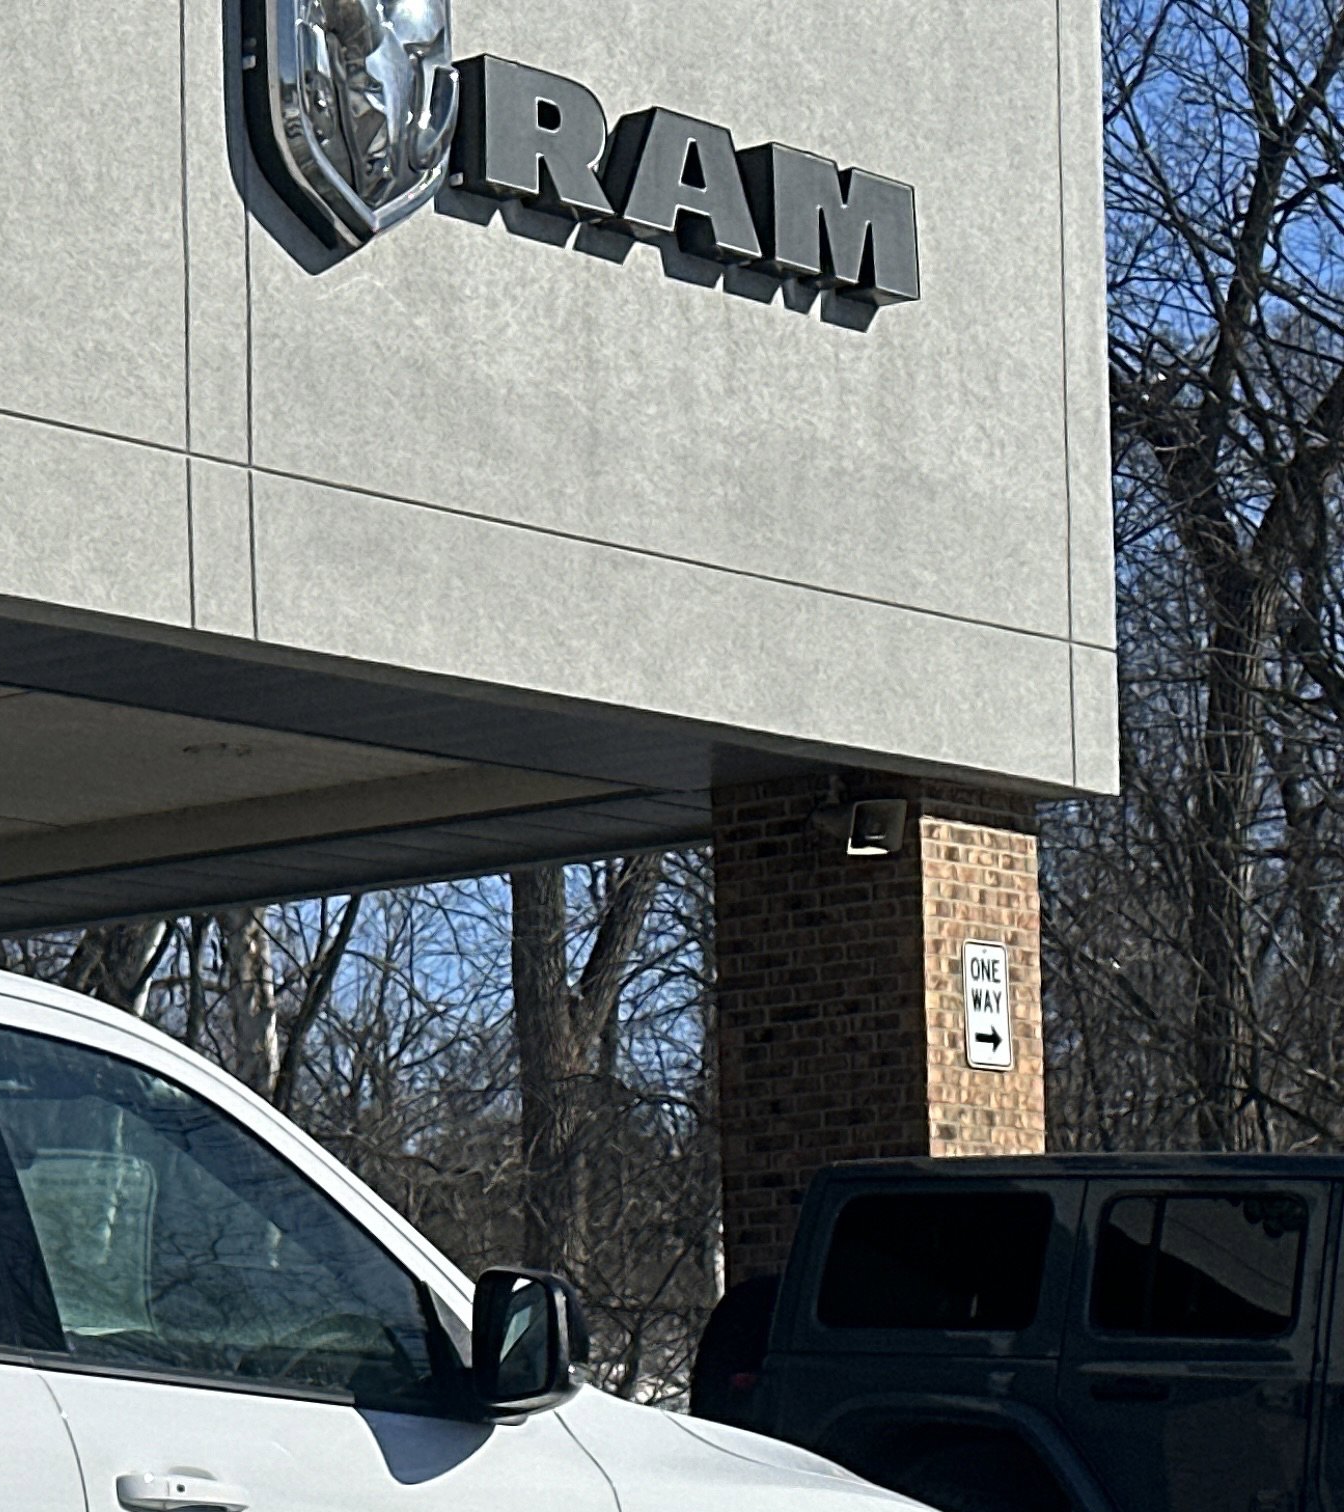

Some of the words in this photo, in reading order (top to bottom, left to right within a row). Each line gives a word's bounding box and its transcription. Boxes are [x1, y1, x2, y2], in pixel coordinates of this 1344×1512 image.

[455, 53, 920, 303] RAM
[970, 957, 1002, 983] ONE
[971, 987, 1002, 1014] WAY
